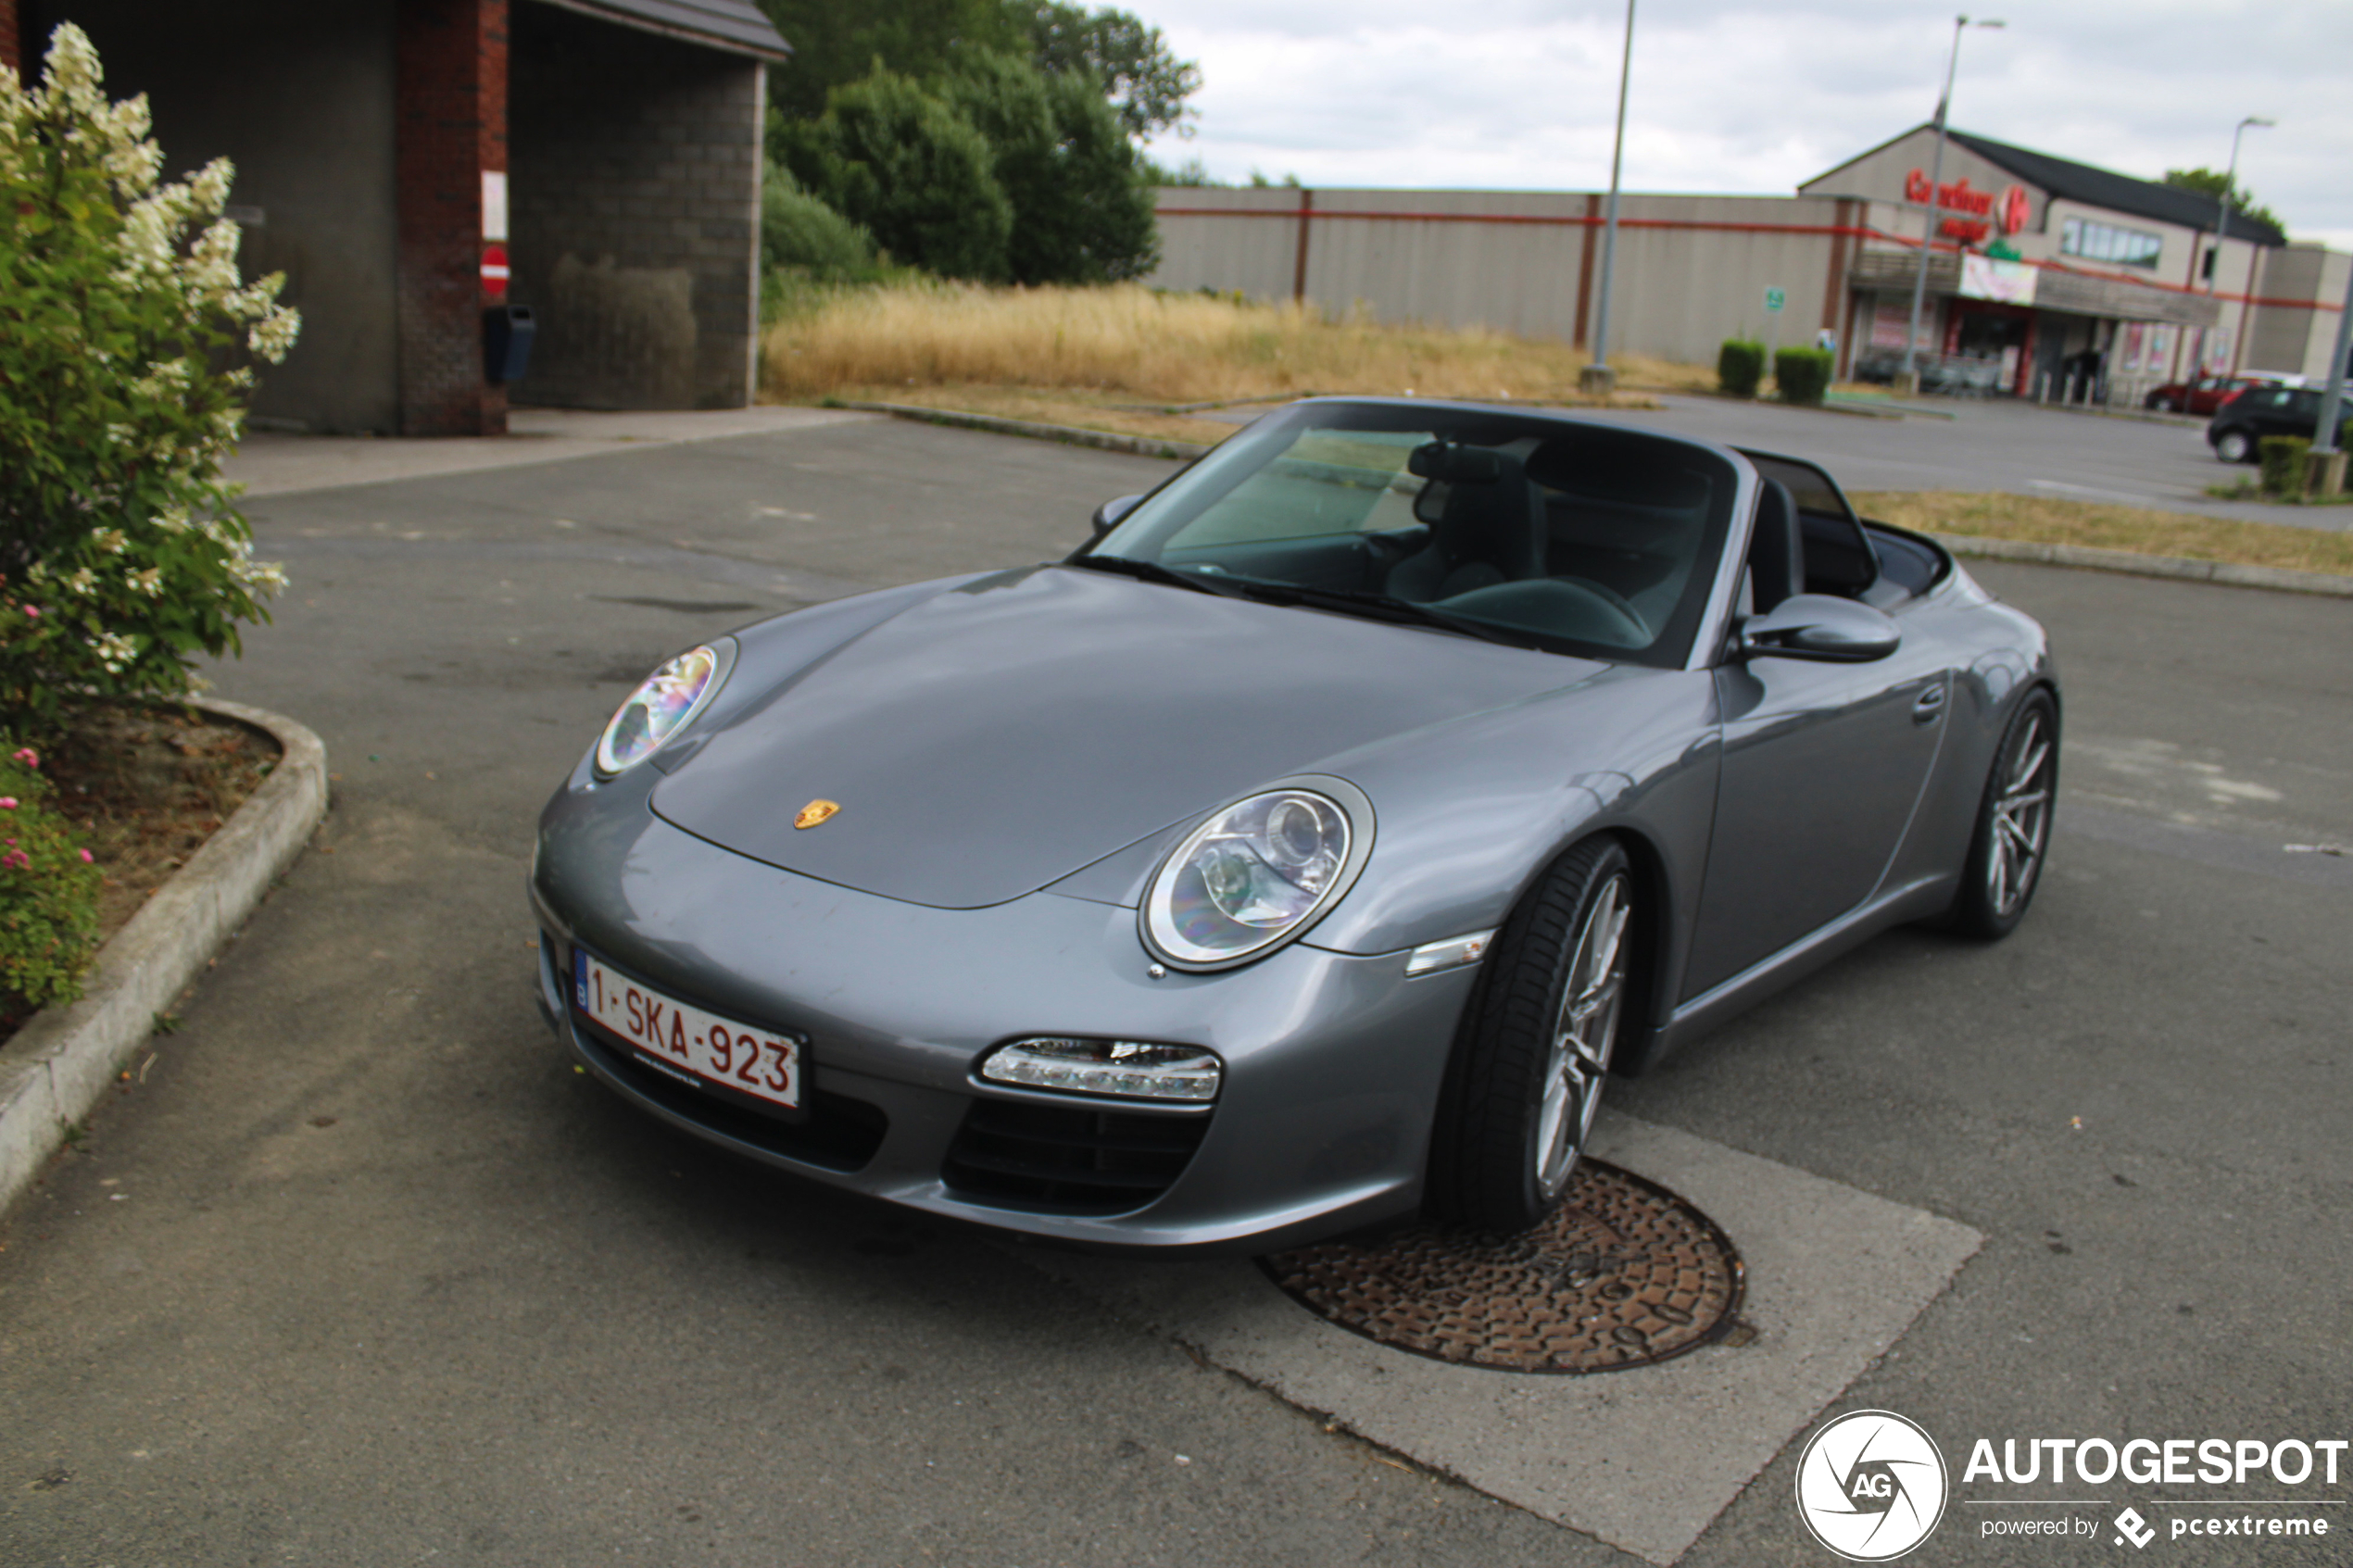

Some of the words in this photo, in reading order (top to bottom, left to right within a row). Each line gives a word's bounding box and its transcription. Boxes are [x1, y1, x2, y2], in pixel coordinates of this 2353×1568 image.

[1905, 169, 1994, 215] Carefour
[576, 983, 587, 1007] B
[592, 968, 790, 1093] 1-SKA-923
